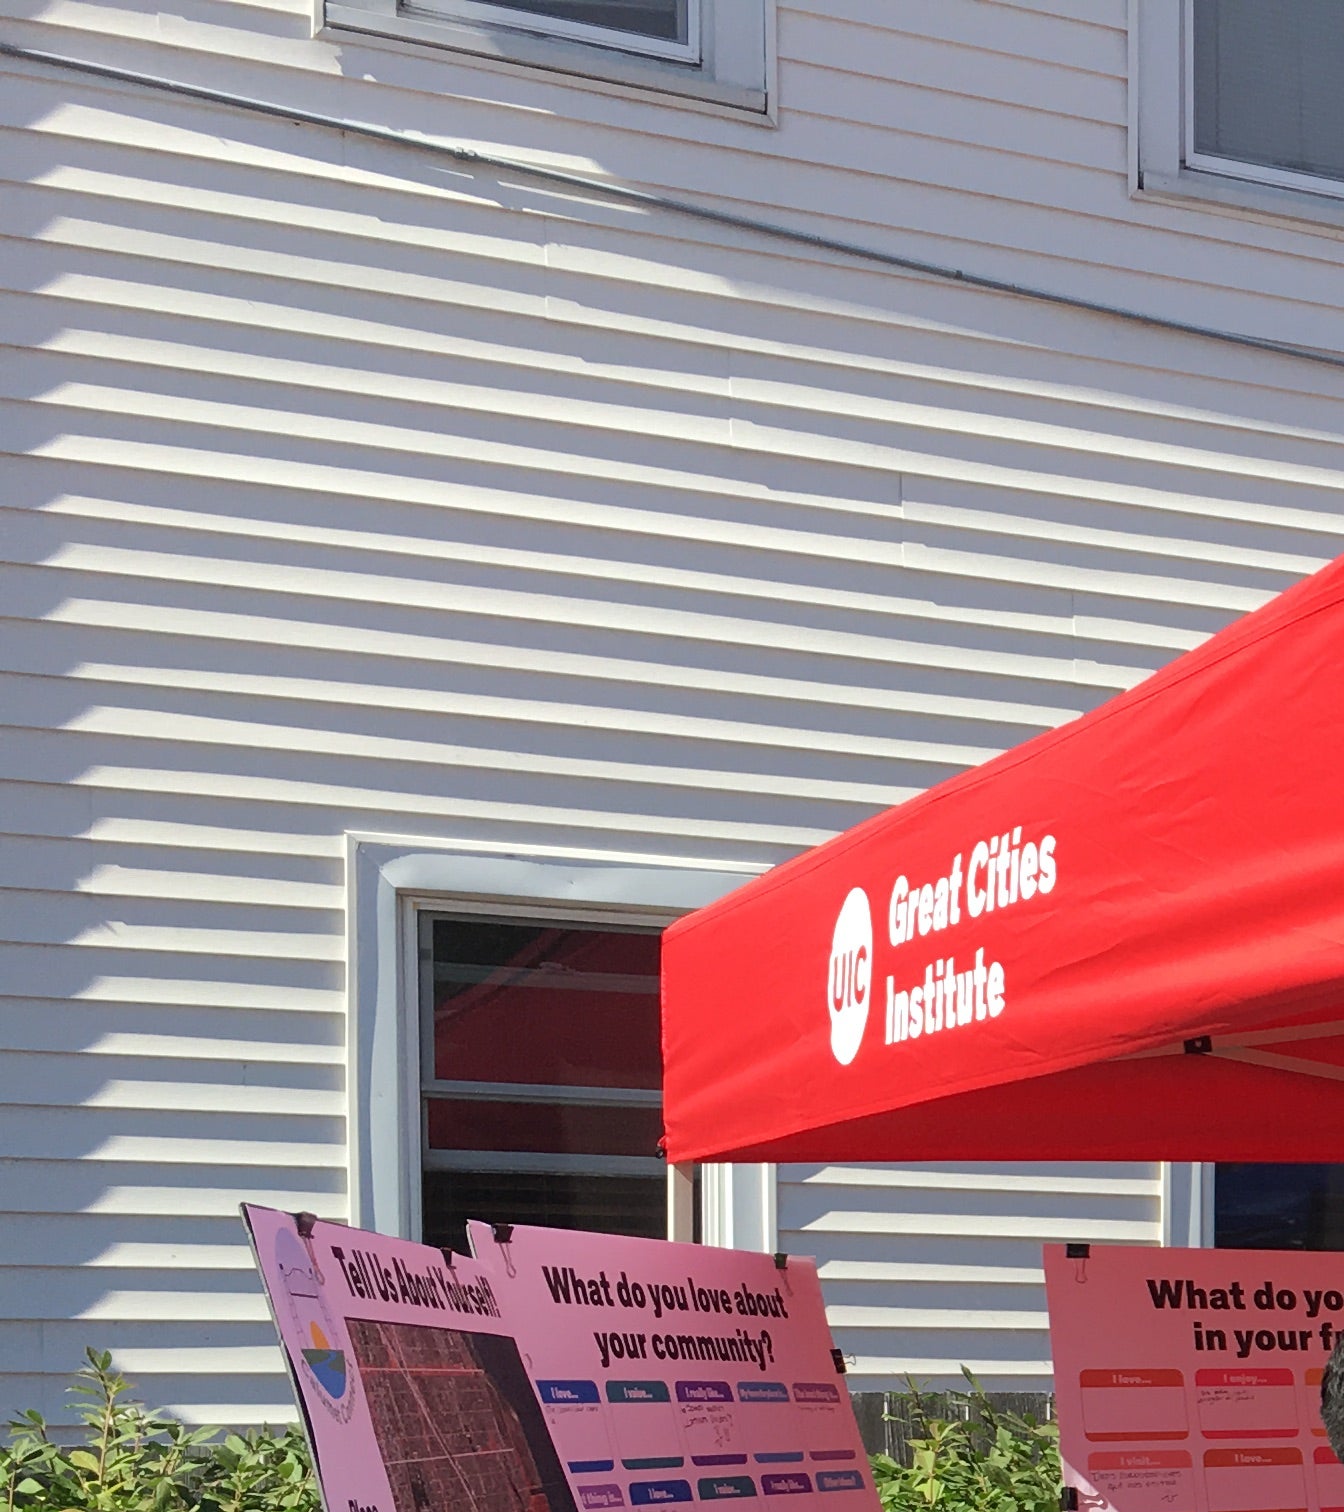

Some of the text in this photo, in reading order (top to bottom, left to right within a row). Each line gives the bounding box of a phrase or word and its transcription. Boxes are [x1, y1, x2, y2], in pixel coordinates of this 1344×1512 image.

[889, 826, 1056, 946] Great Cities
[832, 944, 868, 1012] UIC
[885, 947, 1005, 1045] Institute
[331, 1246, 501, 1318] Tell Us About Yourself!
[541, 1266, 789, 1318] What do you love about
[1146, 1279, 1246, 1309] What
[1253, 1281, 1297, 1310] do
[593, 1329, 775, 1371] your community?
[1194, 1322, 1227, 1351] in
[1234, 1329, 1313, 1358] your
